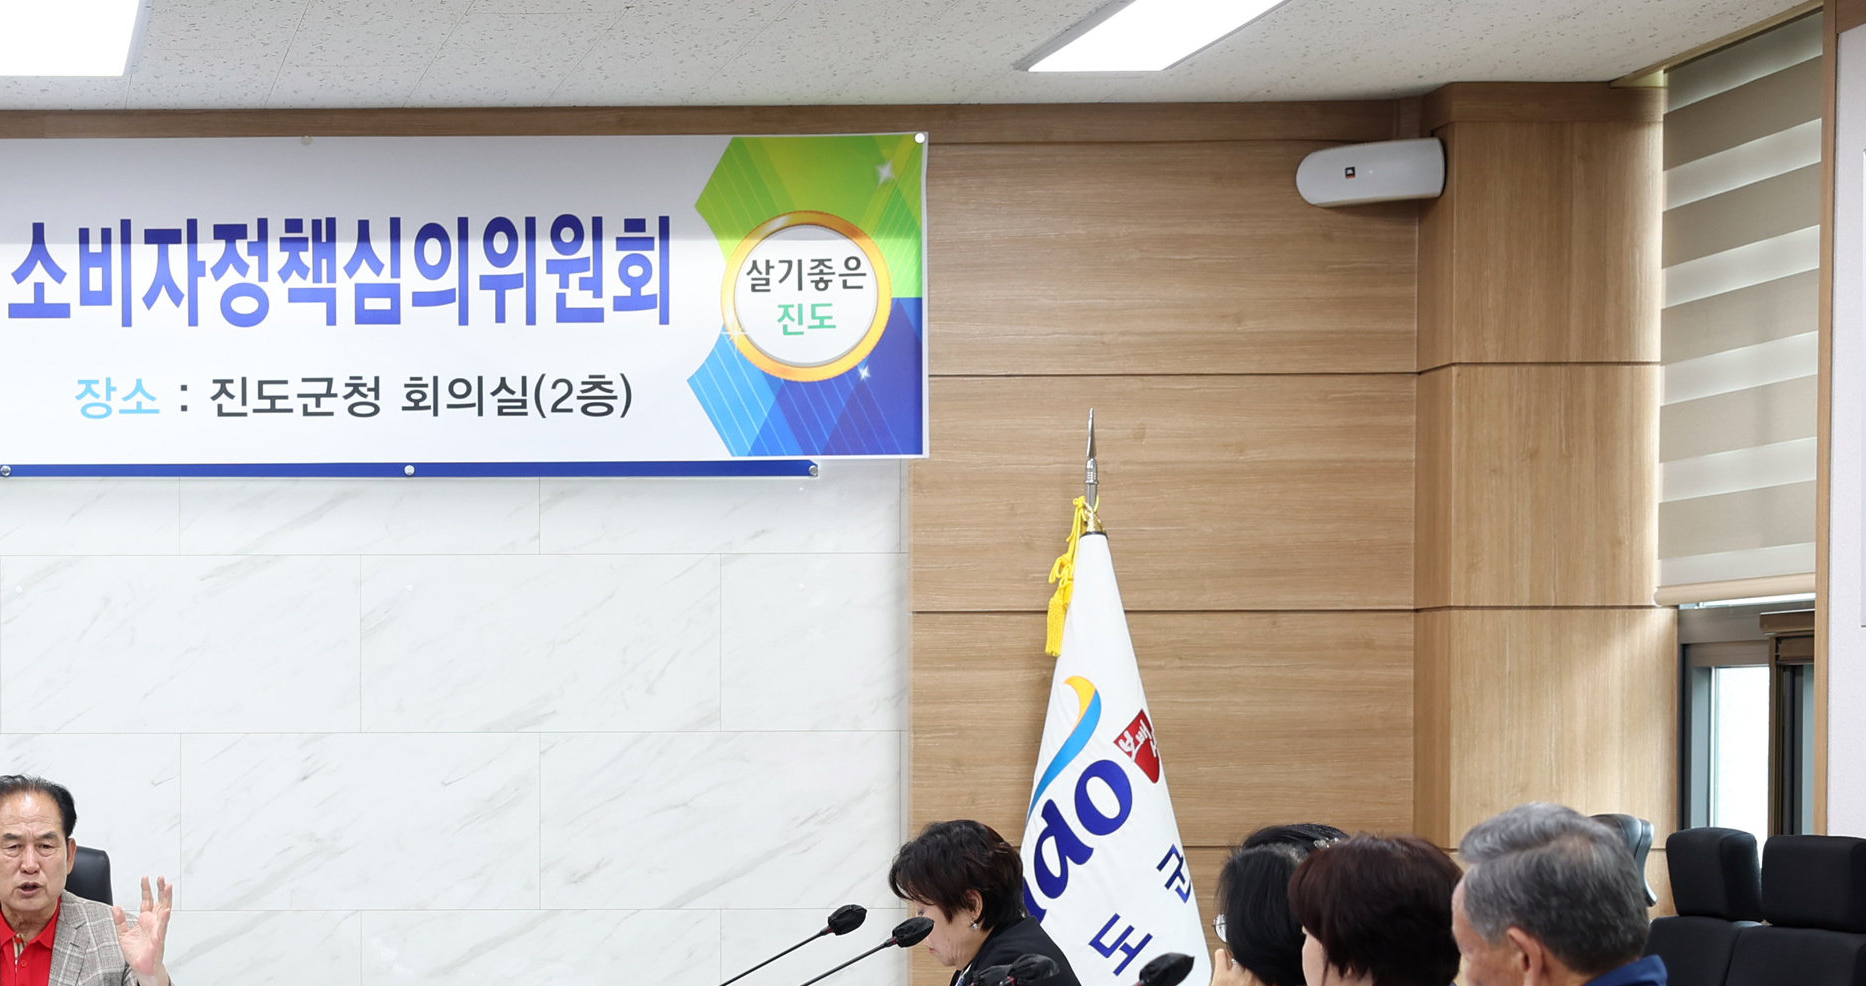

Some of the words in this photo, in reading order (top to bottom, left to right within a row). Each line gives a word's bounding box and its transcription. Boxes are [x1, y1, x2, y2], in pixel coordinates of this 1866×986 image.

[8, 214, 671, 327] 소비자정책심의위원회
[745, 254, 867, 292] 살기좋은
[777, 302, 837, 336] 진도
[75, 376, 161, 419] 장소
[209, 375, 381, 418] 진도군청
[401, 372, 633, 419] 회의실(2층)
